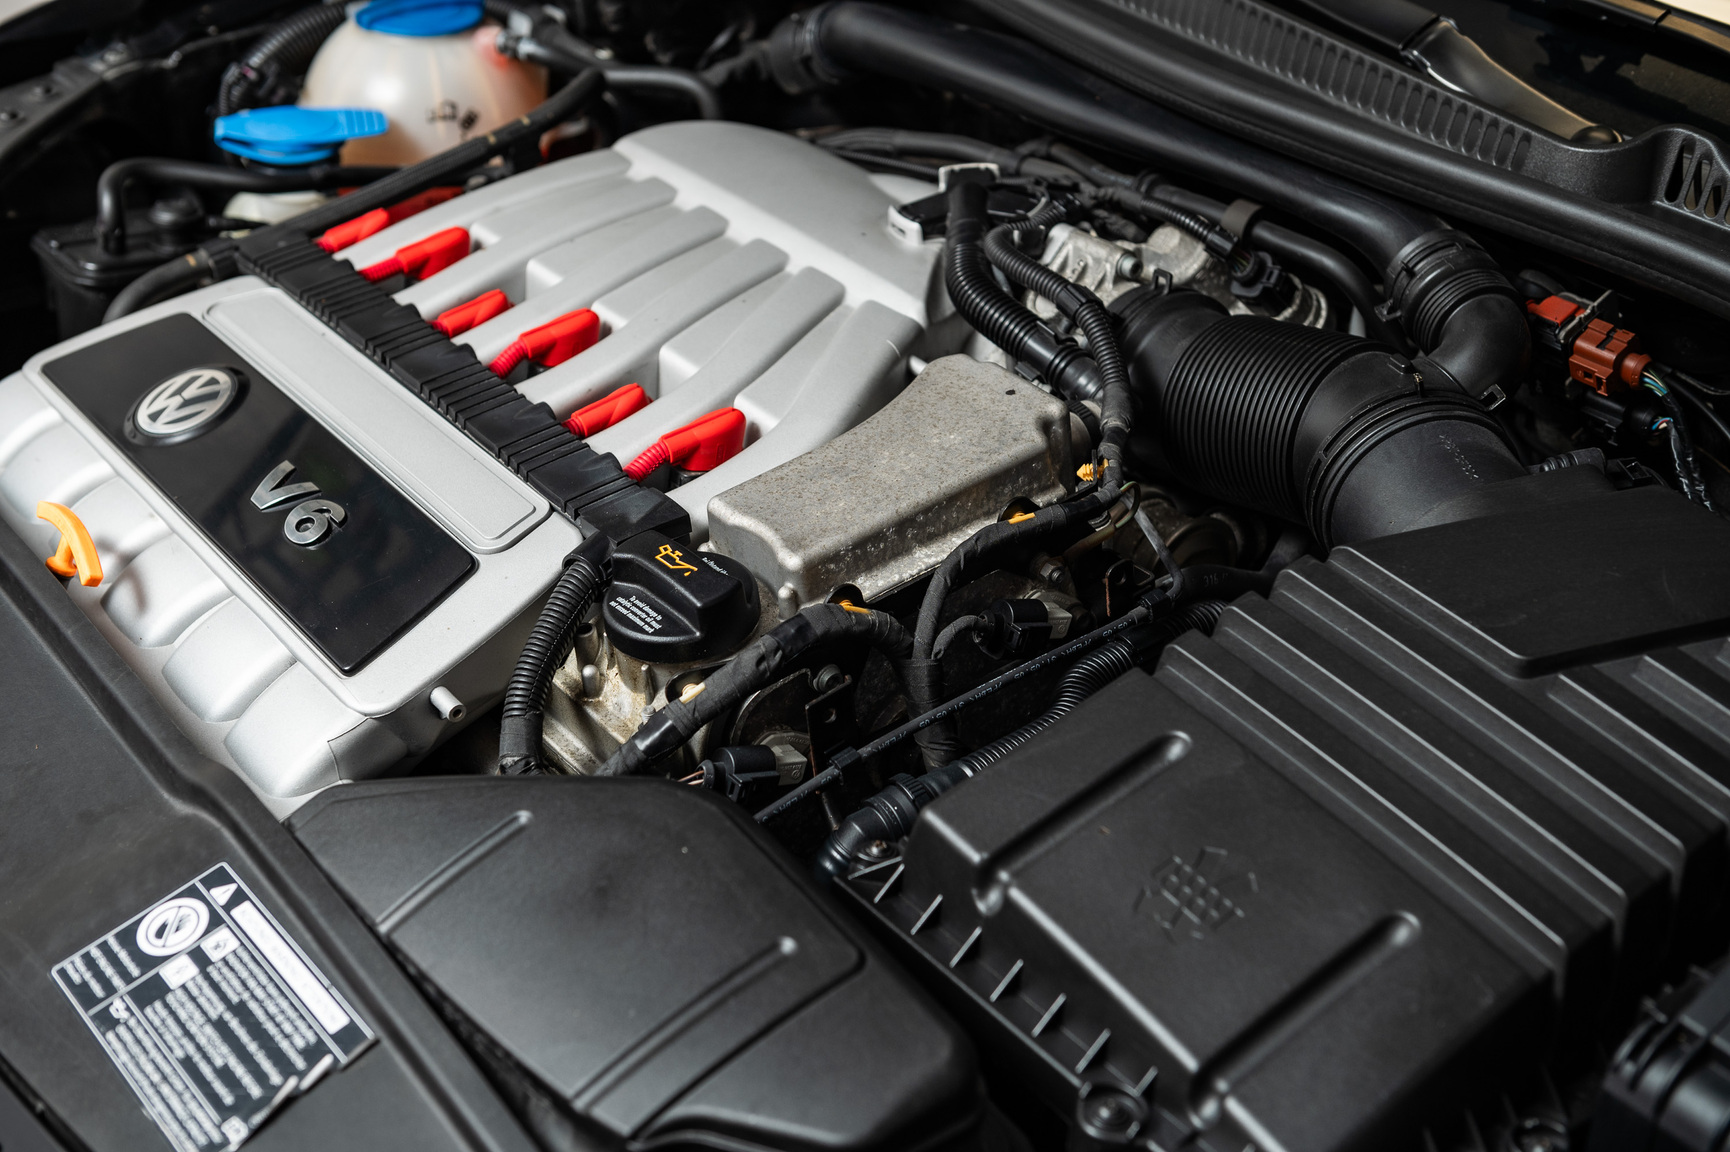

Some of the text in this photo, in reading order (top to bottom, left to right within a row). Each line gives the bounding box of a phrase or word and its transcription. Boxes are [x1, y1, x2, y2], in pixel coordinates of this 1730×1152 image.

[250, 459, 349, 546] V6
[609, 600, 655, 633] not exceed maximum mark
[616, 596, 632, 608] catalytic
[629, 605, 648, 619] converter
[650, 620, 662, 630] must
[633, 599, 647, 608] avoid
[643, 605, 658, 618] damage
